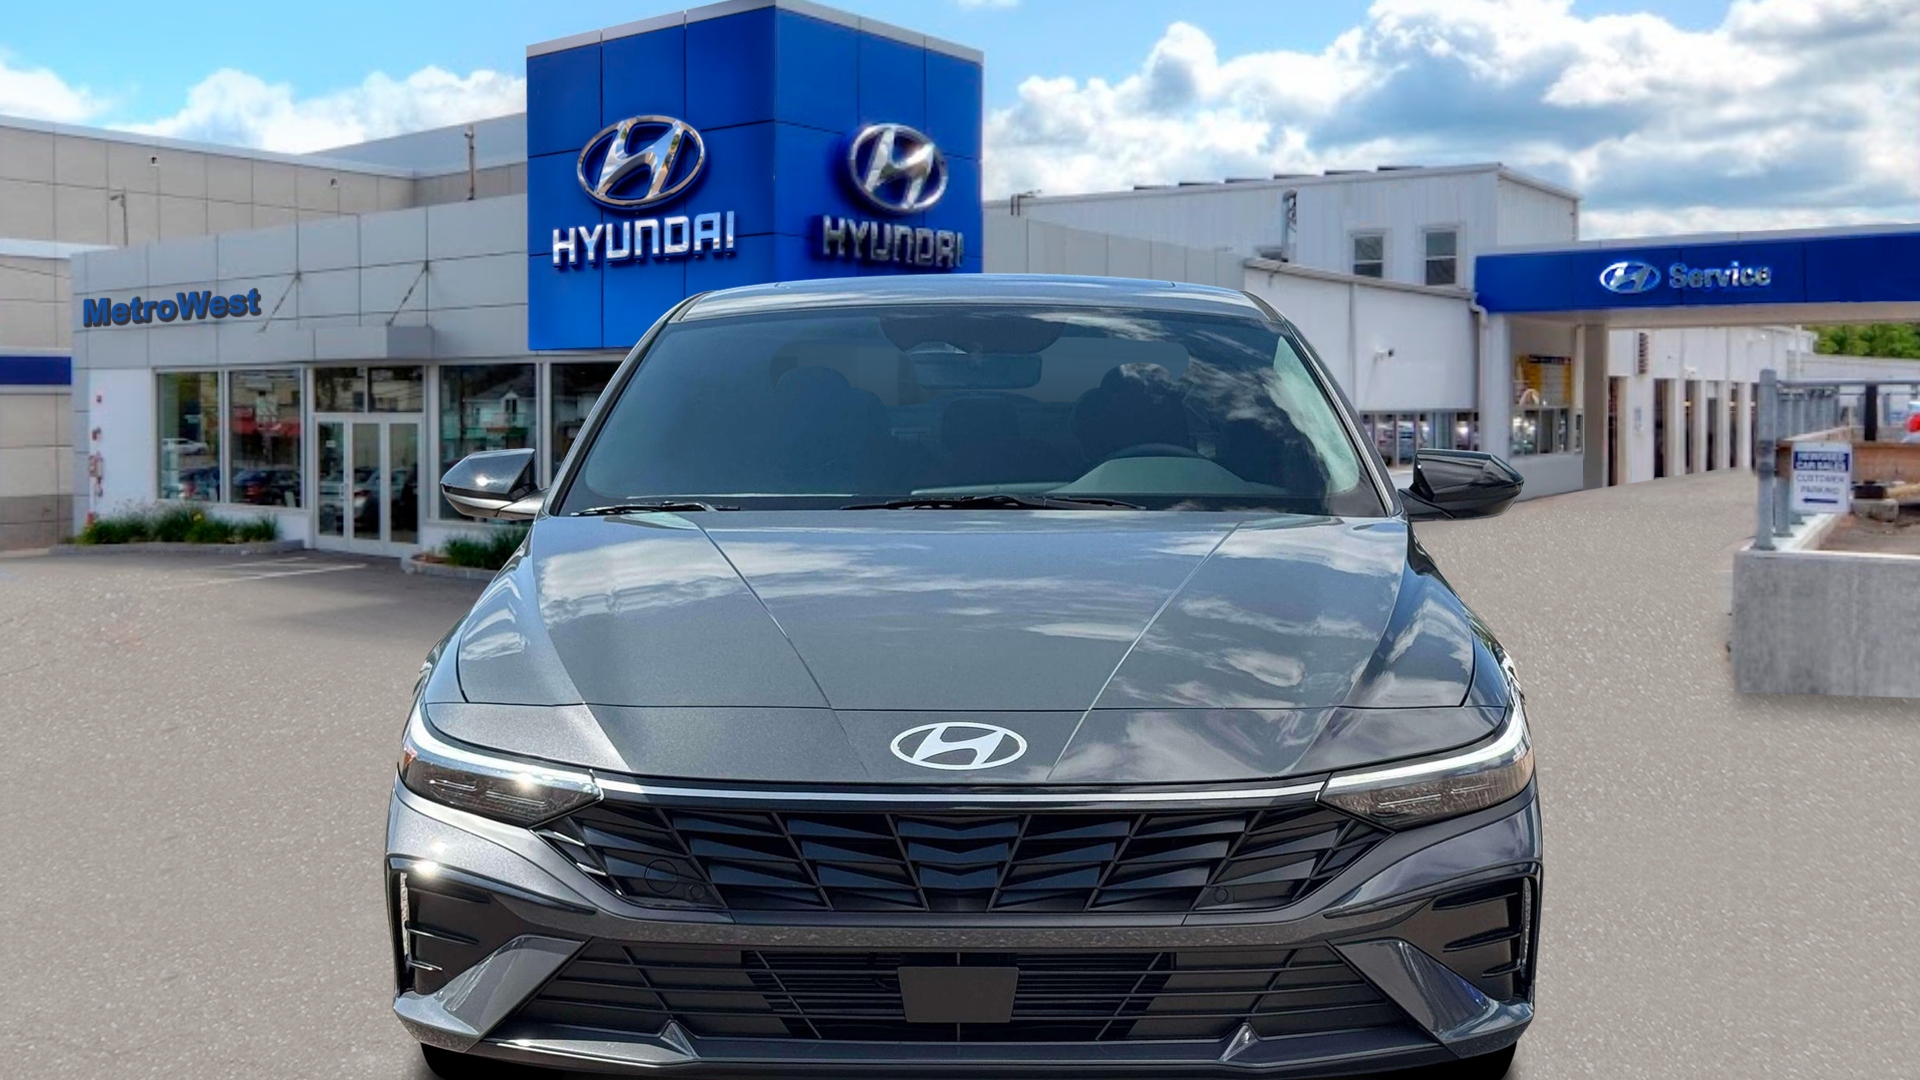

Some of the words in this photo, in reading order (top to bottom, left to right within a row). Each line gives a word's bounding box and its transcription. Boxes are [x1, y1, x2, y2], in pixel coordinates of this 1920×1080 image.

[552, 210, 735, 265] HYUNDAI
[822, 214, 965, 268] HYUNDAI
[1668, 260, 1772, 289] Service
[83, 287, 262, 328] MetroWest
